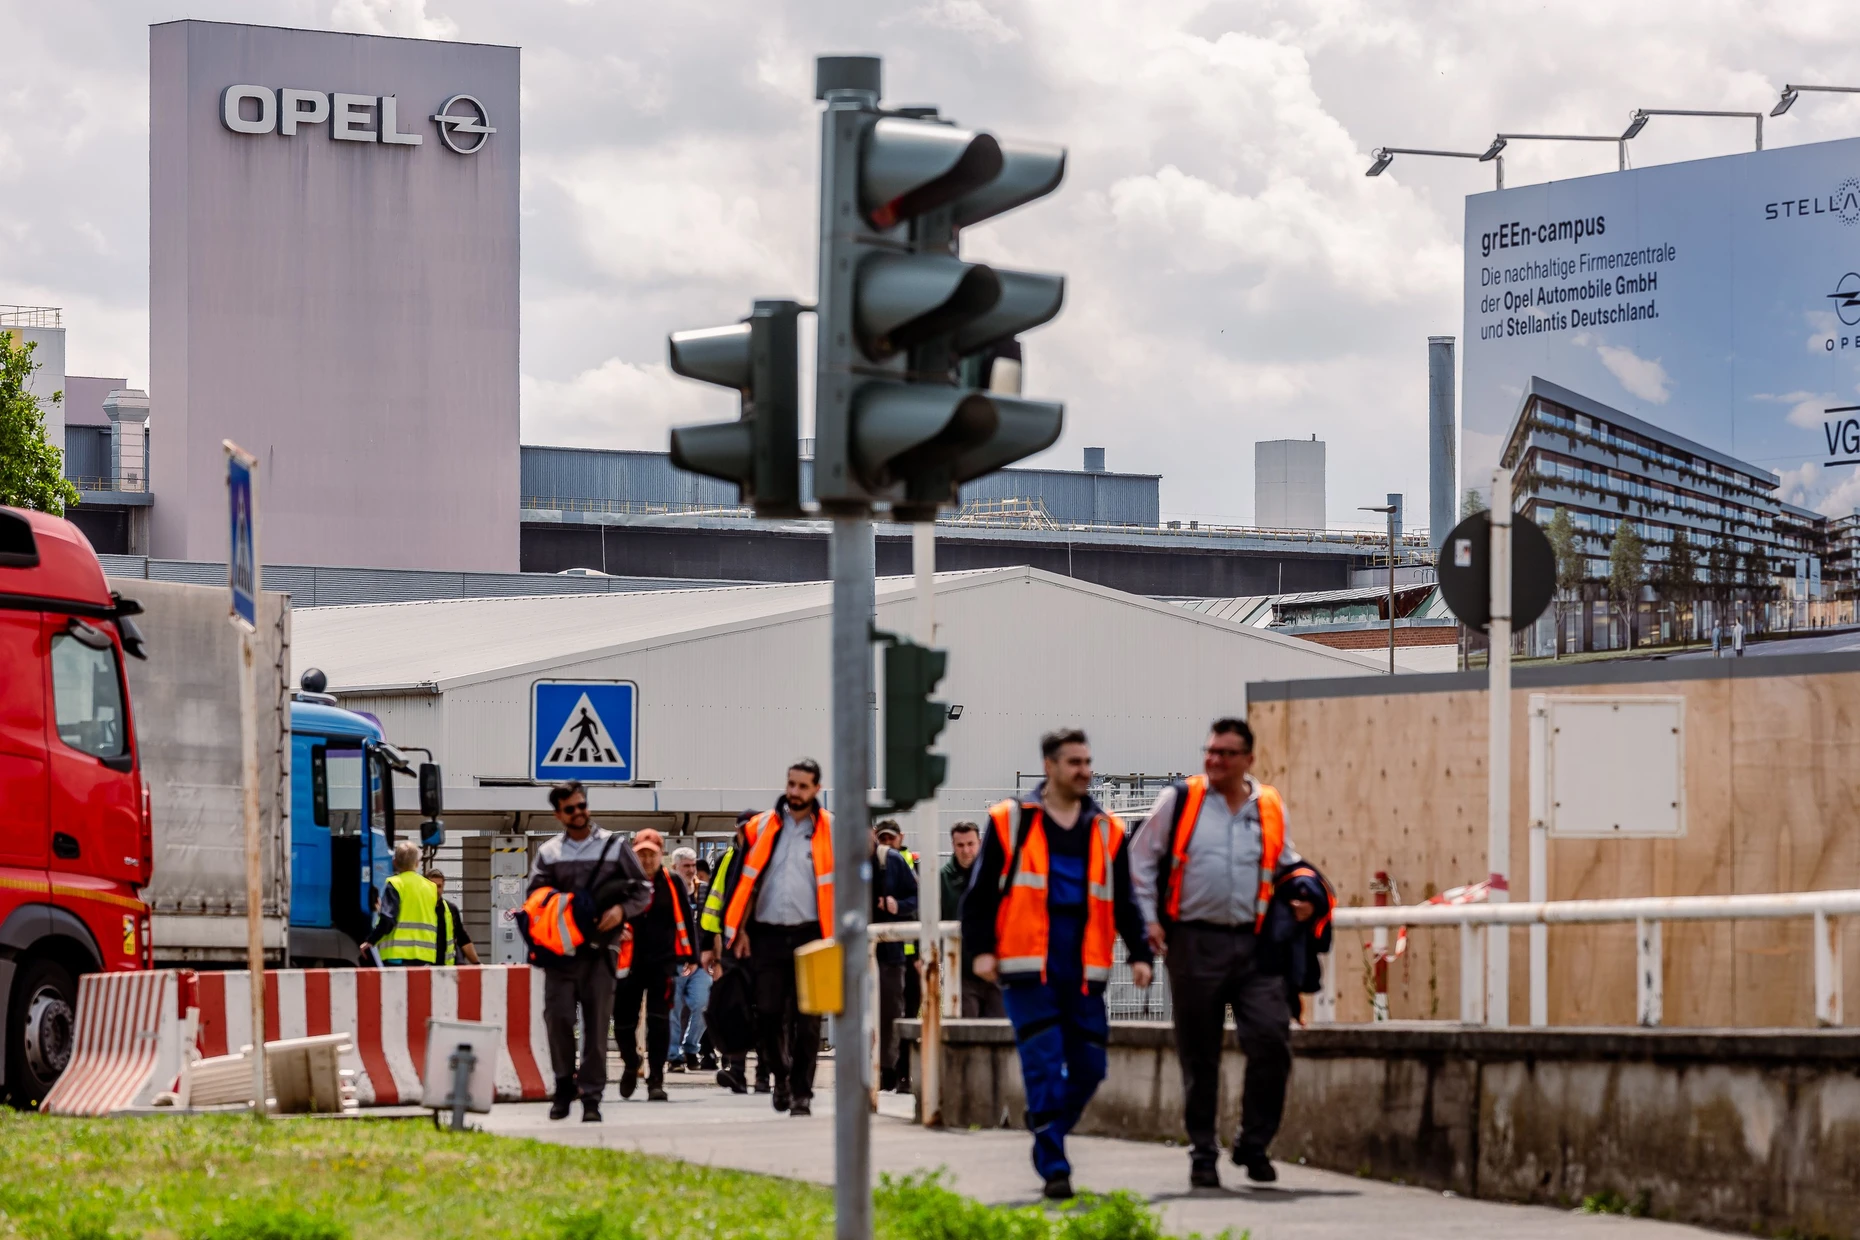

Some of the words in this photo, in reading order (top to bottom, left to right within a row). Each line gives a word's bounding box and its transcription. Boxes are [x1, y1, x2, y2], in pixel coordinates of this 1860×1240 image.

[219, 84, 423, 146] OPEL
[1481, 215, 1606, 257] grEEn-campus
[1481, 267, 1501, 287] Die
[1504, 258, 1576, 284] nachhaltige
[1579, 242, 1677, 273] Firmenzentrale
[1480, 294, 1501, 314] der
[1504, 288, 1534, 313] Opel
[1536, 278, 1612, 307] Automobile
[1615, 271, 1658, 296] GmbH
[1480, 319, 1503, 341] und
[1506, 311, 1568, 337] Stellantis
[1571, 299, 1660, 329] Deutschland.
